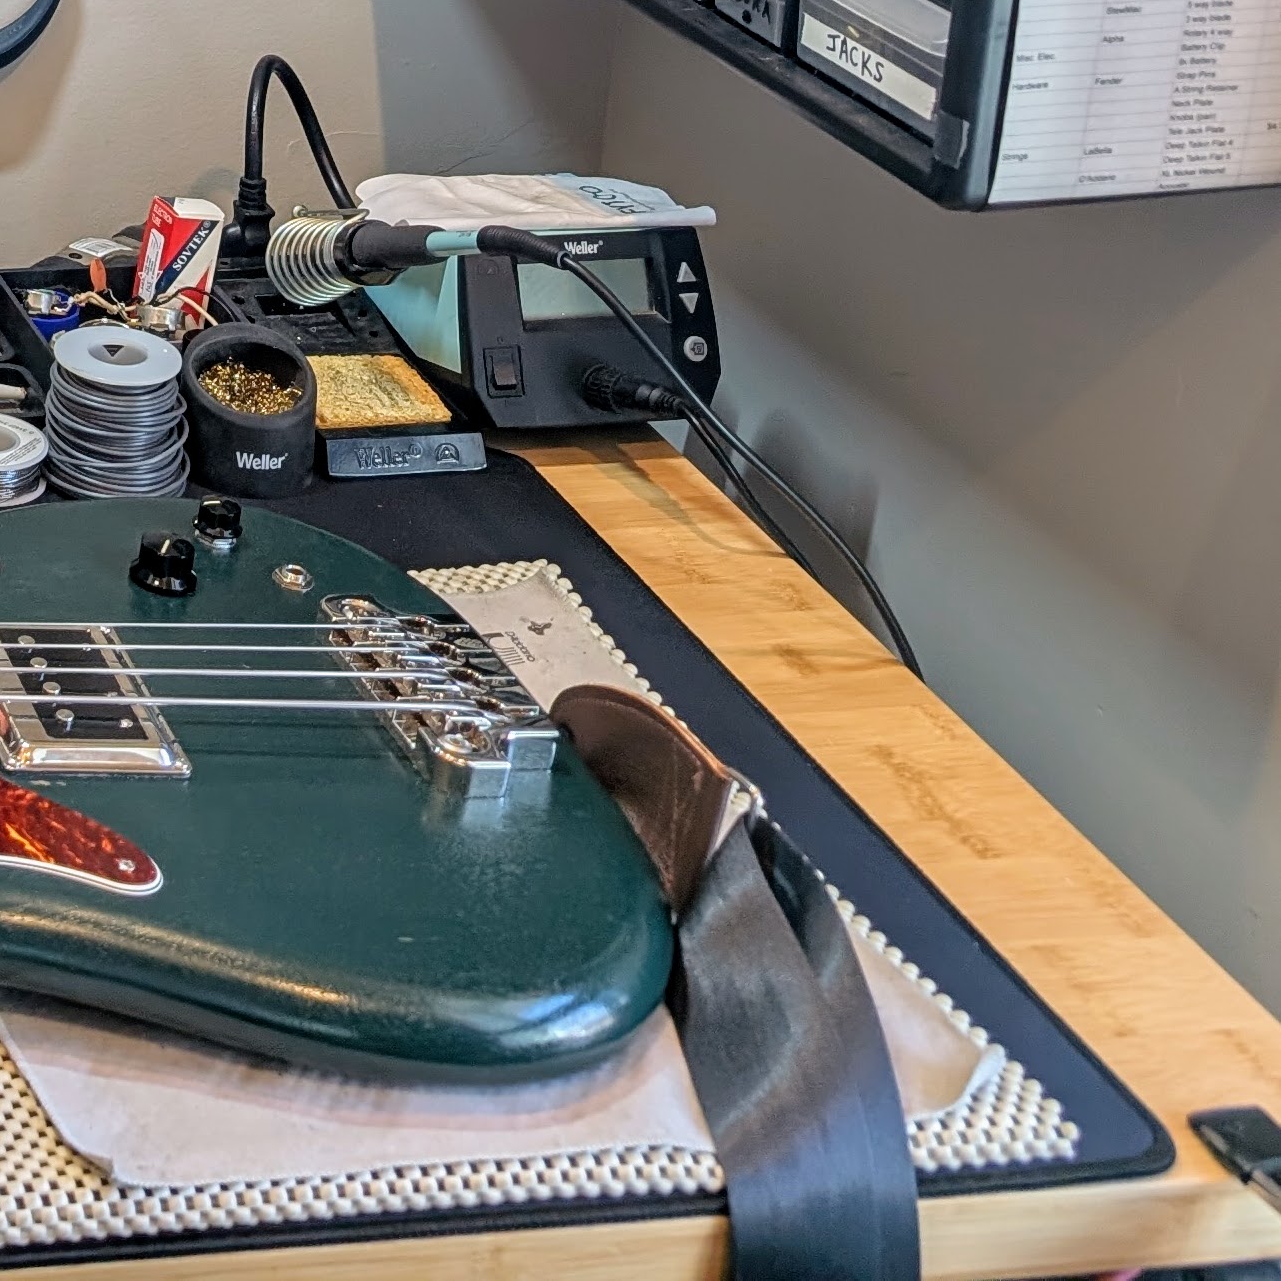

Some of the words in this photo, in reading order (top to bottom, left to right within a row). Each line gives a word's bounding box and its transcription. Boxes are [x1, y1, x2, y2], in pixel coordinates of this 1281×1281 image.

[1102, 34, 1125, 44] Alpha
[826, 31, 885, 86] JACKS
[1012, 80, 1049, 90] Hardware
[1094, 76, 1123, 85] Fender
[172, 225, 210, 272] SOVTEK
[564, 240, 600, 256] Weller
[236, 451, 287, 470] Weller
[353, 445, 410, 470] Weller
